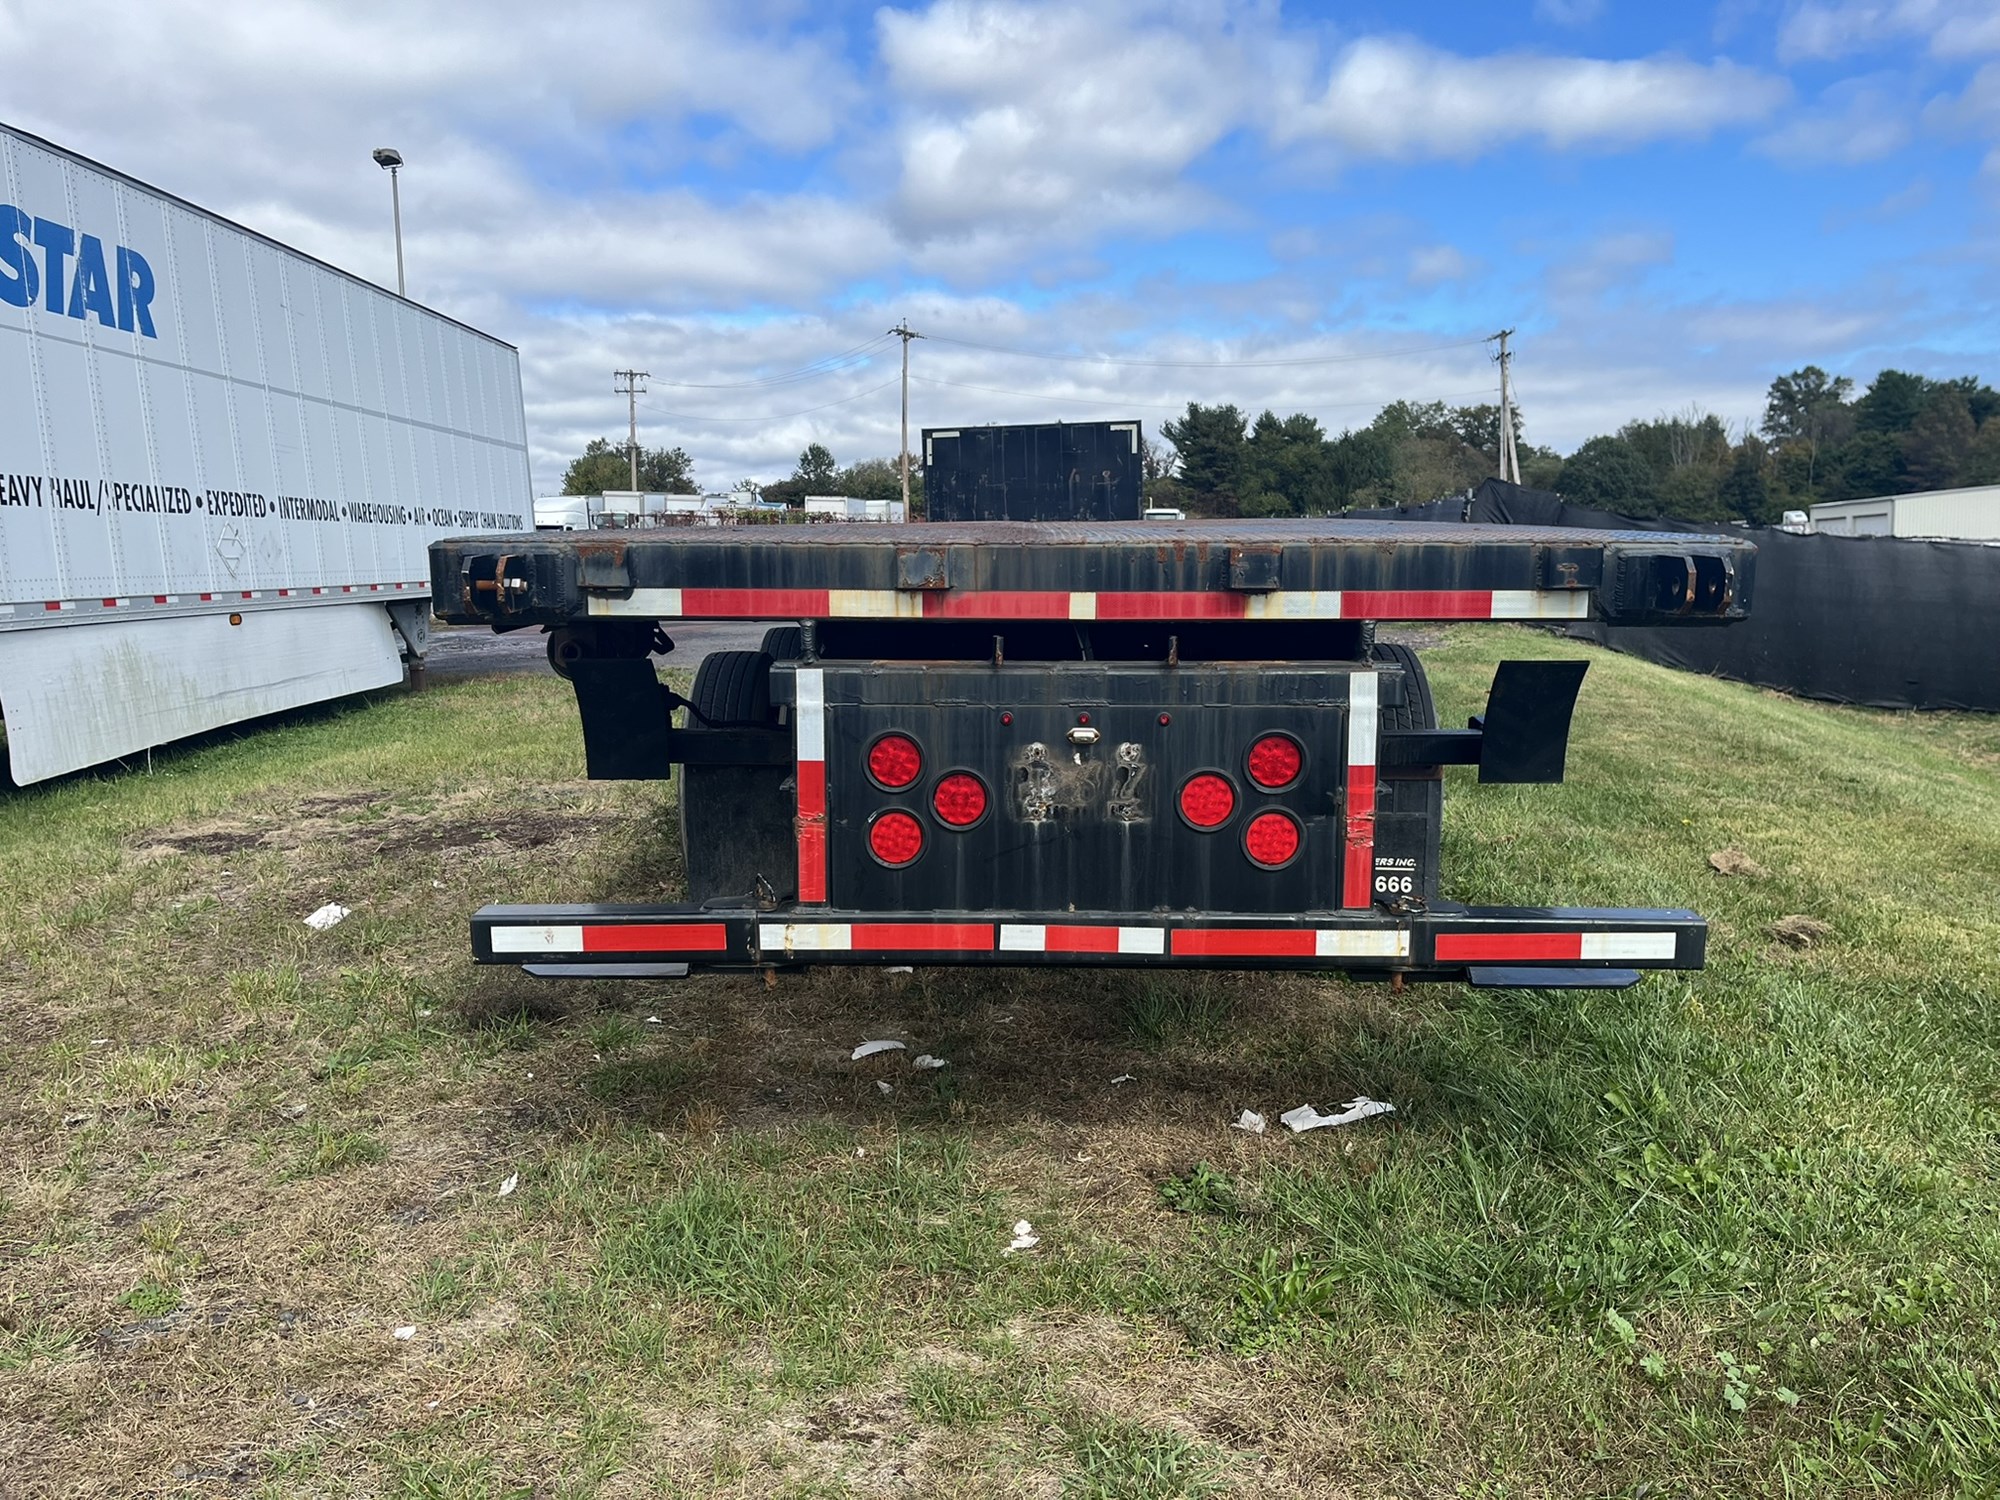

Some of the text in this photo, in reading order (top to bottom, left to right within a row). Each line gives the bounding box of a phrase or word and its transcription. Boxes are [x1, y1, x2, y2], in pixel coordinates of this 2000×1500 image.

[0, 204, 157, 339] STAR
[206, 490, 267, 518] EXPEDITED
[278, 496, 340, 521] INTERMODAL
[348, 502, 406, 525] WAREHOUSING
[414, 507, 426, 525] AIR
[432, 508, 453, 527] OCEAN
[459, 510, 479, 528] SUPPLY
[481, 512, 497, 529] CHAIN
[497, 513, 523, 530] SOLUTIONS
[1395, 858, 1416, 867] INC.
[1375, 876, 1412, 893] 666
